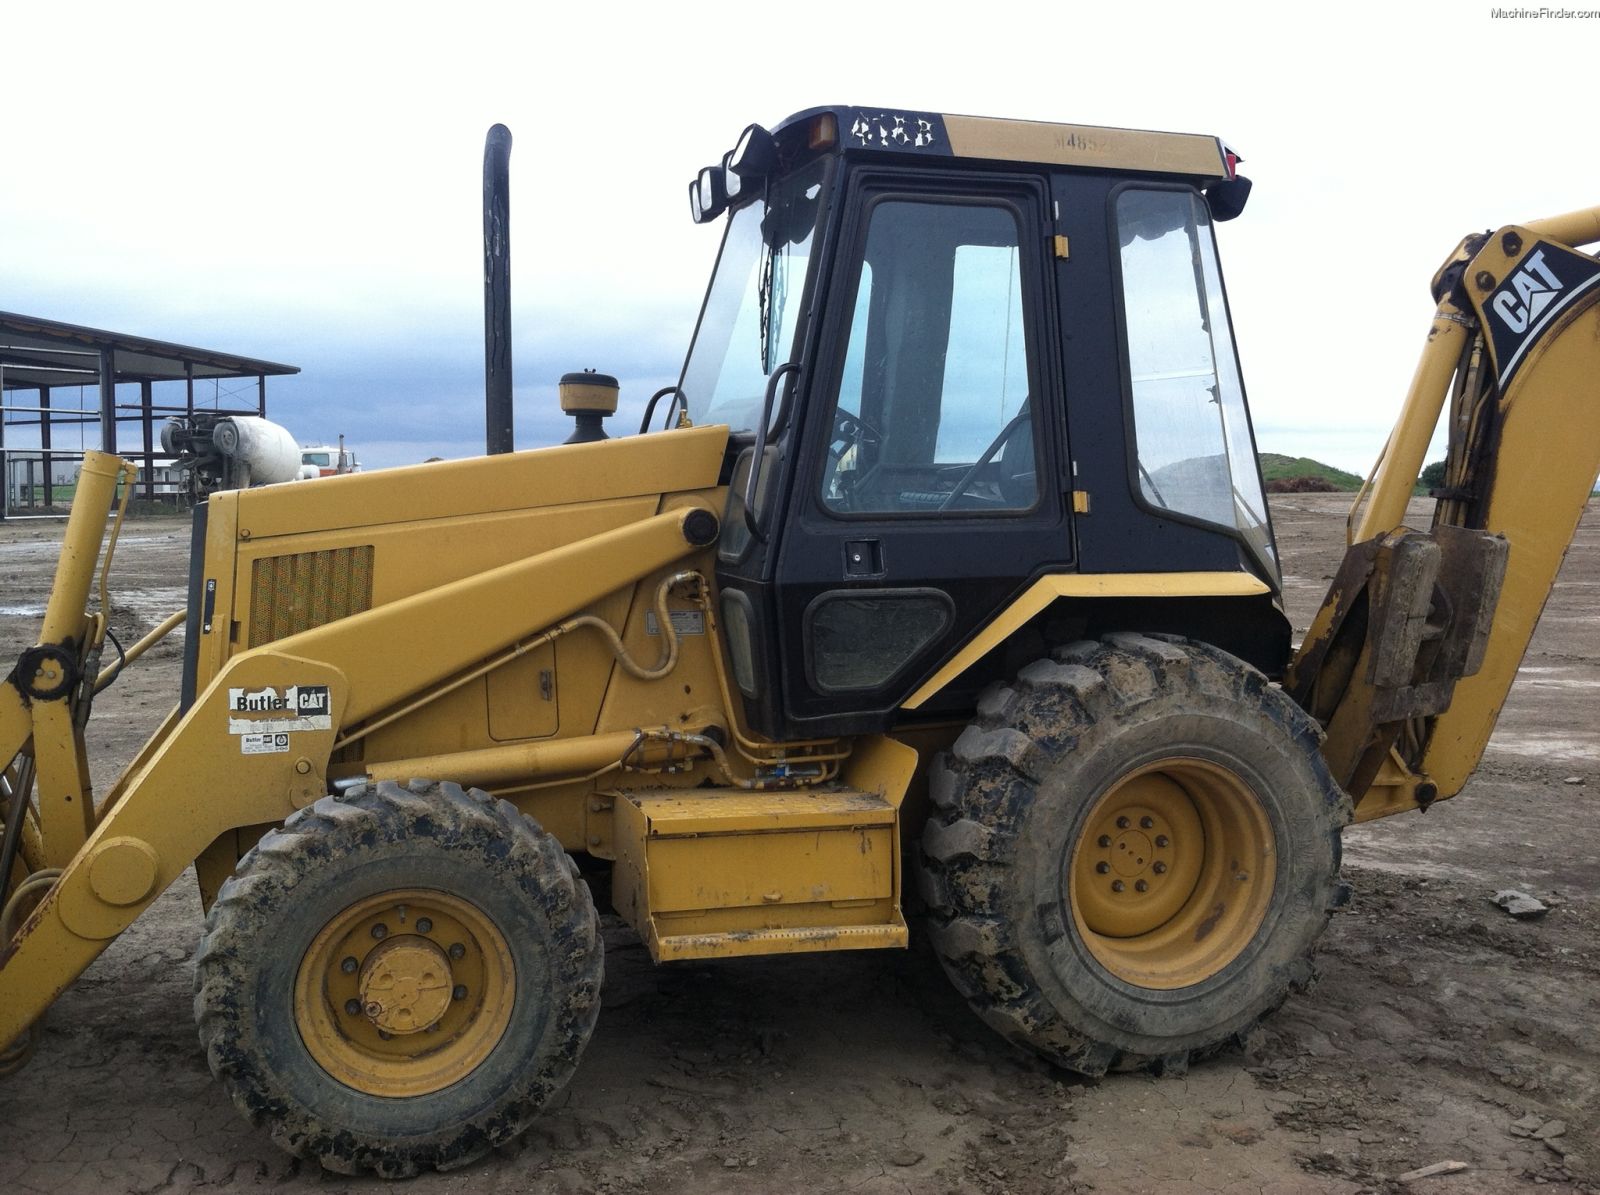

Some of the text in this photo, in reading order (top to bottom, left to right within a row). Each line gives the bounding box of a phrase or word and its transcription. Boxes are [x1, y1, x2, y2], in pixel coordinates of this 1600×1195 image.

[1493, 249, 1564, 334] CAT
[237, 693, 326, 711] Butler CAT
